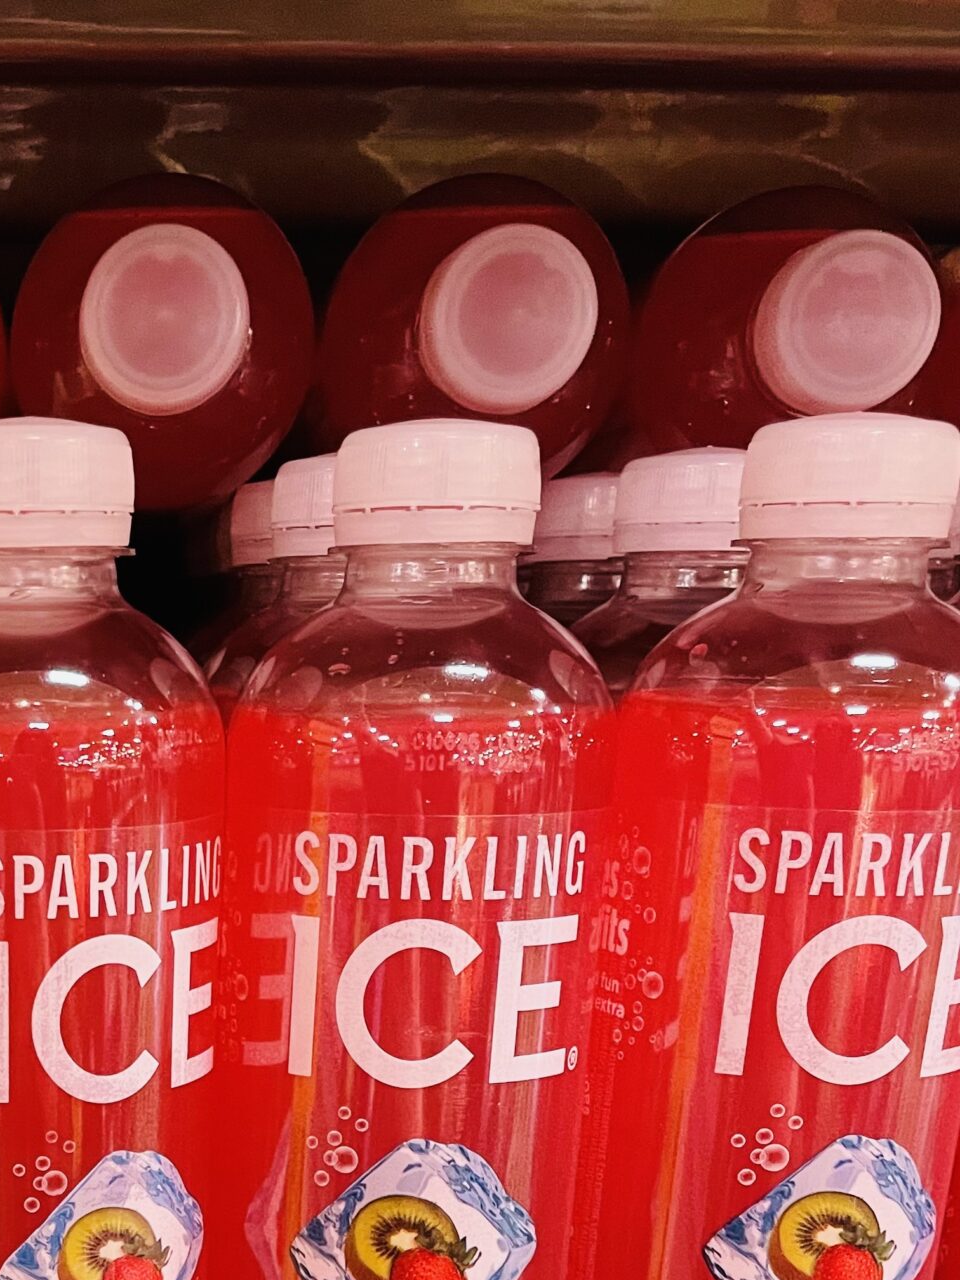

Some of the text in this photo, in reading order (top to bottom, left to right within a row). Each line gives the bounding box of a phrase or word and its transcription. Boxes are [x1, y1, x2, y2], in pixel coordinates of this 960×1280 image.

[293, 830, 586, 901] SPARKLING
[734, 828, 960, 897] SPARKL
[288, 914, 579, 1089] ICE
